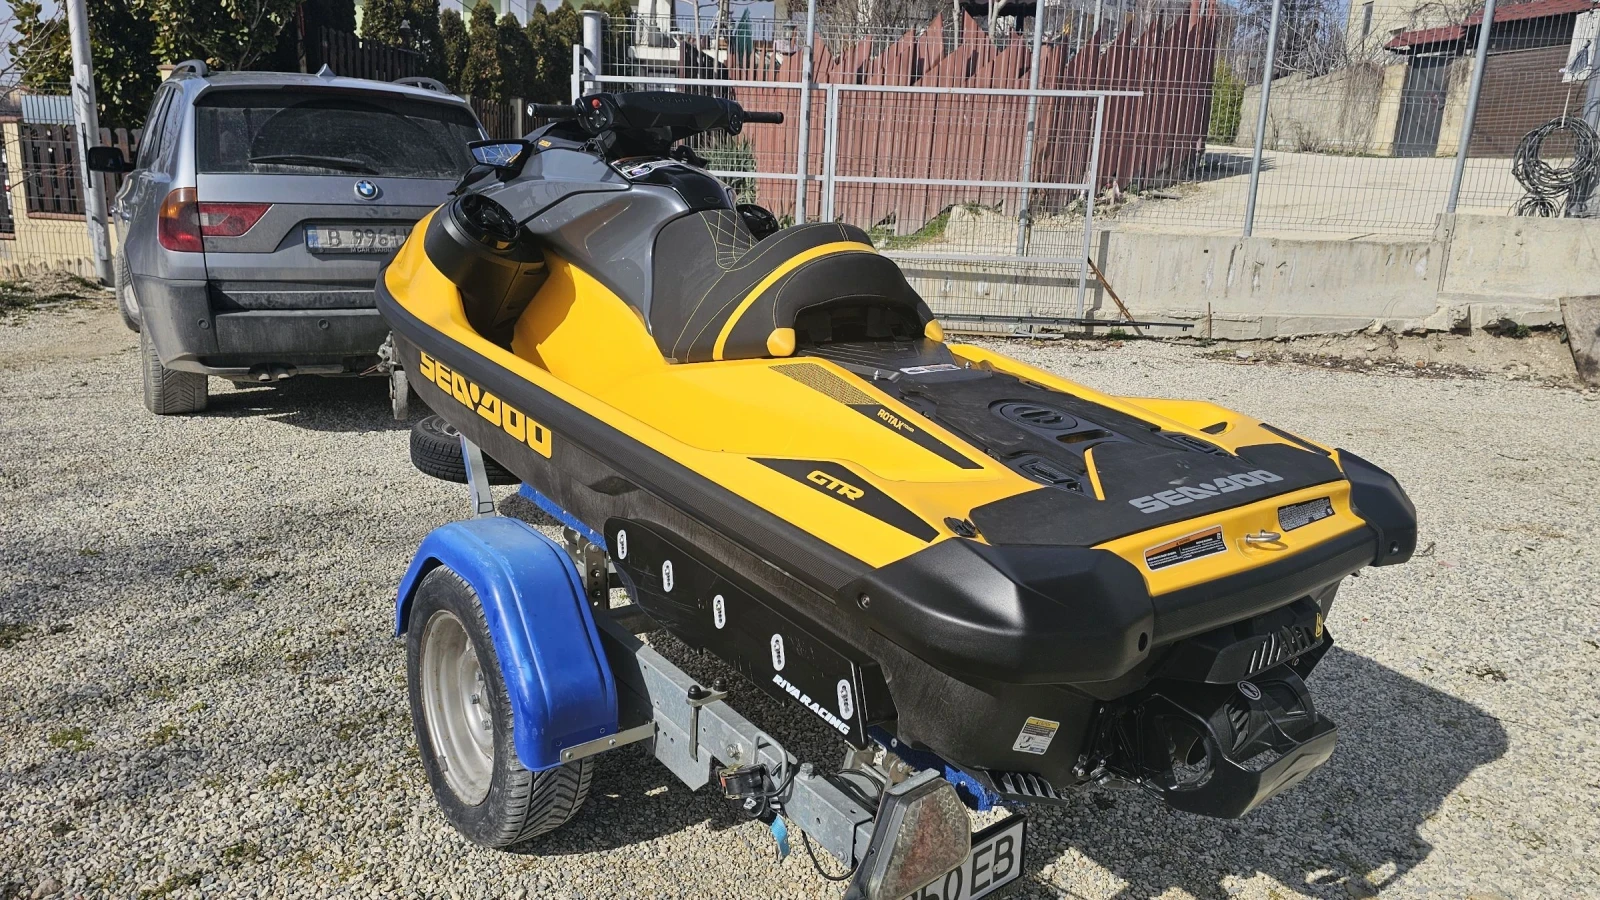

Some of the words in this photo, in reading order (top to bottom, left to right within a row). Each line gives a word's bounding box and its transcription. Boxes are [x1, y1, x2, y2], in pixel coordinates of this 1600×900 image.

[327, 229, 341, 247] B
[877, 408, 905, 430] ROTAX
[806, 470, 865, 501] GTR
[773, 674, 800, 700] RIVA
[799, 694, 851, 735] RACING
[970, 834, 1014, 897] EB
